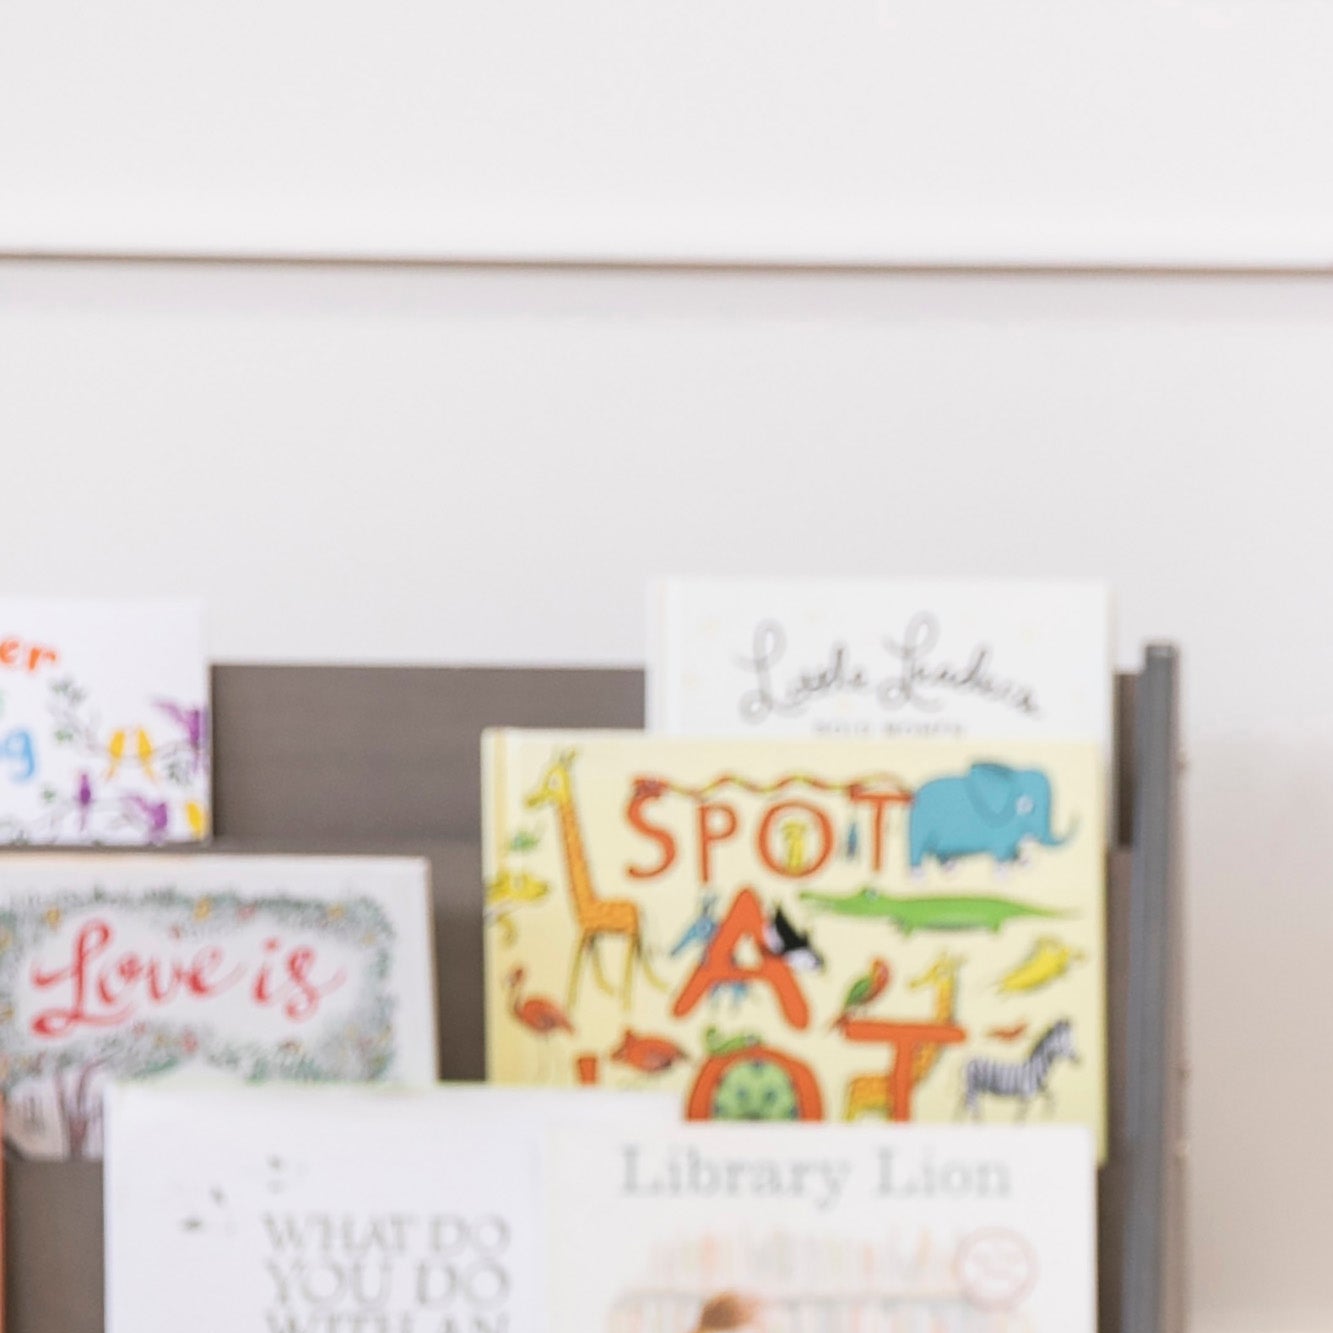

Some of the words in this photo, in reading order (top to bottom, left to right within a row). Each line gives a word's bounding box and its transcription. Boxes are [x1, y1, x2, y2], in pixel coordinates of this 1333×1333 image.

[625, 785, 914, 884] SPOT
[31, 918, 246, 1037] Love
[252, 935, 348, 1020] is
[672, 887, 810, 1029] A
[618, 1142, 852, 1209] Library
[873, 1142, 1012, 1199] Lion
[262, 1212, 414, 1257] WHAT
[430, 1212, 511, 1255] DO
[266, 1258, 395, 1305] YOU
[416, 1258, 512, 1306] DO
